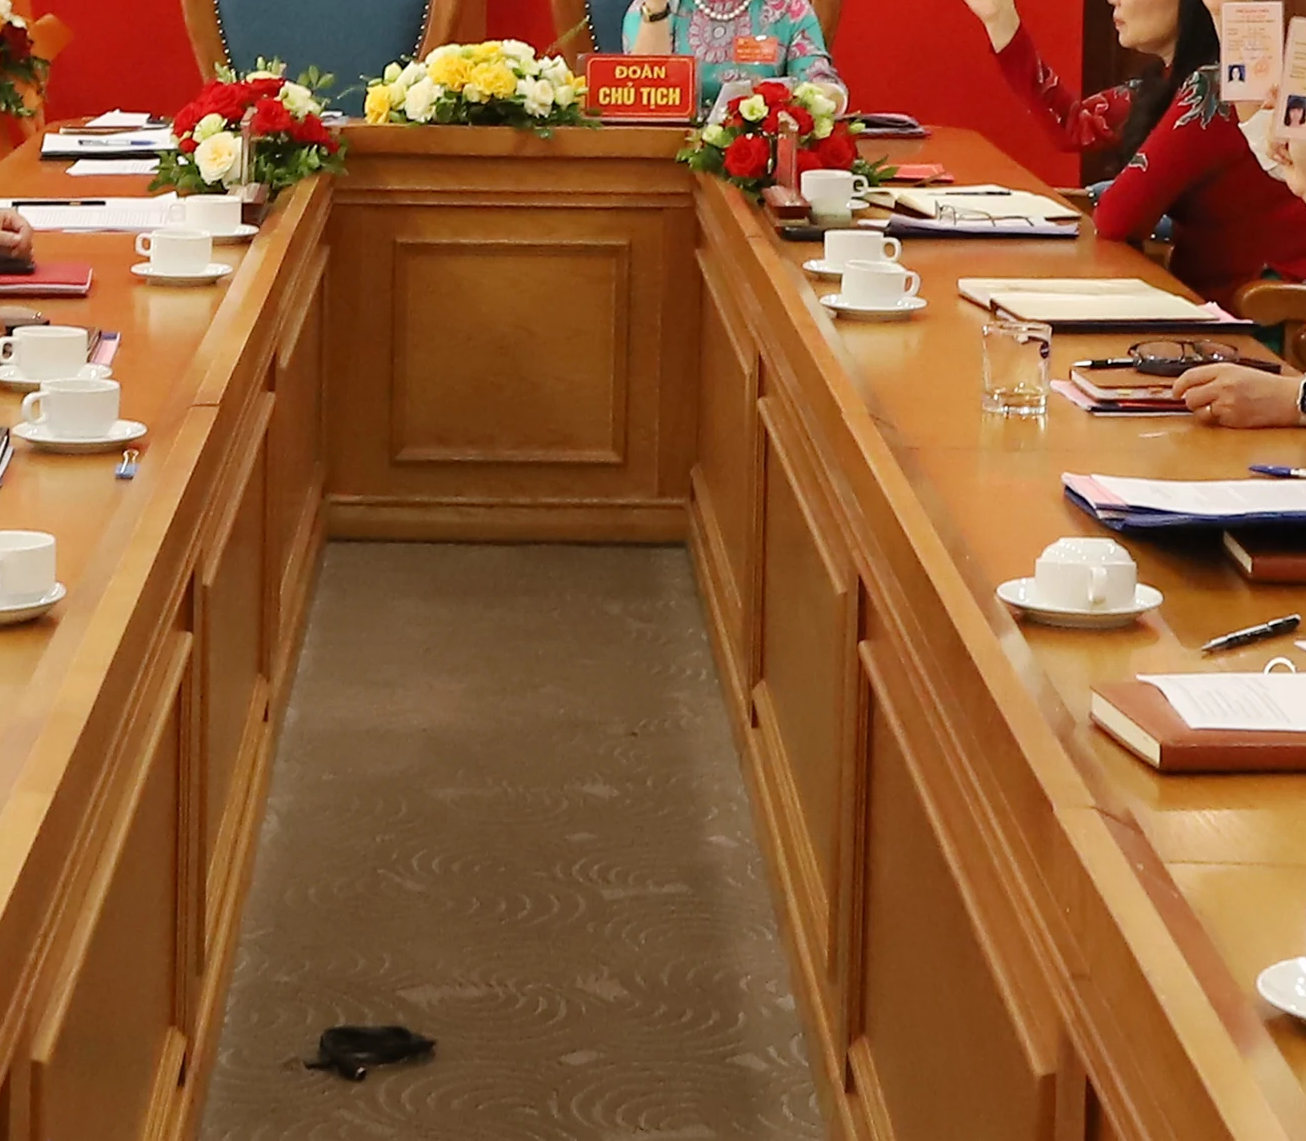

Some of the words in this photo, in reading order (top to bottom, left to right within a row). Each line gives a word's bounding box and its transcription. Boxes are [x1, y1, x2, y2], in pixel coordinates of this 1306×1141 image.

[614, 63, 666, 79] ĐOÀN
[598, 81, 636, 106] CHỦ
[640, 87, 681, 110] TỊCH
